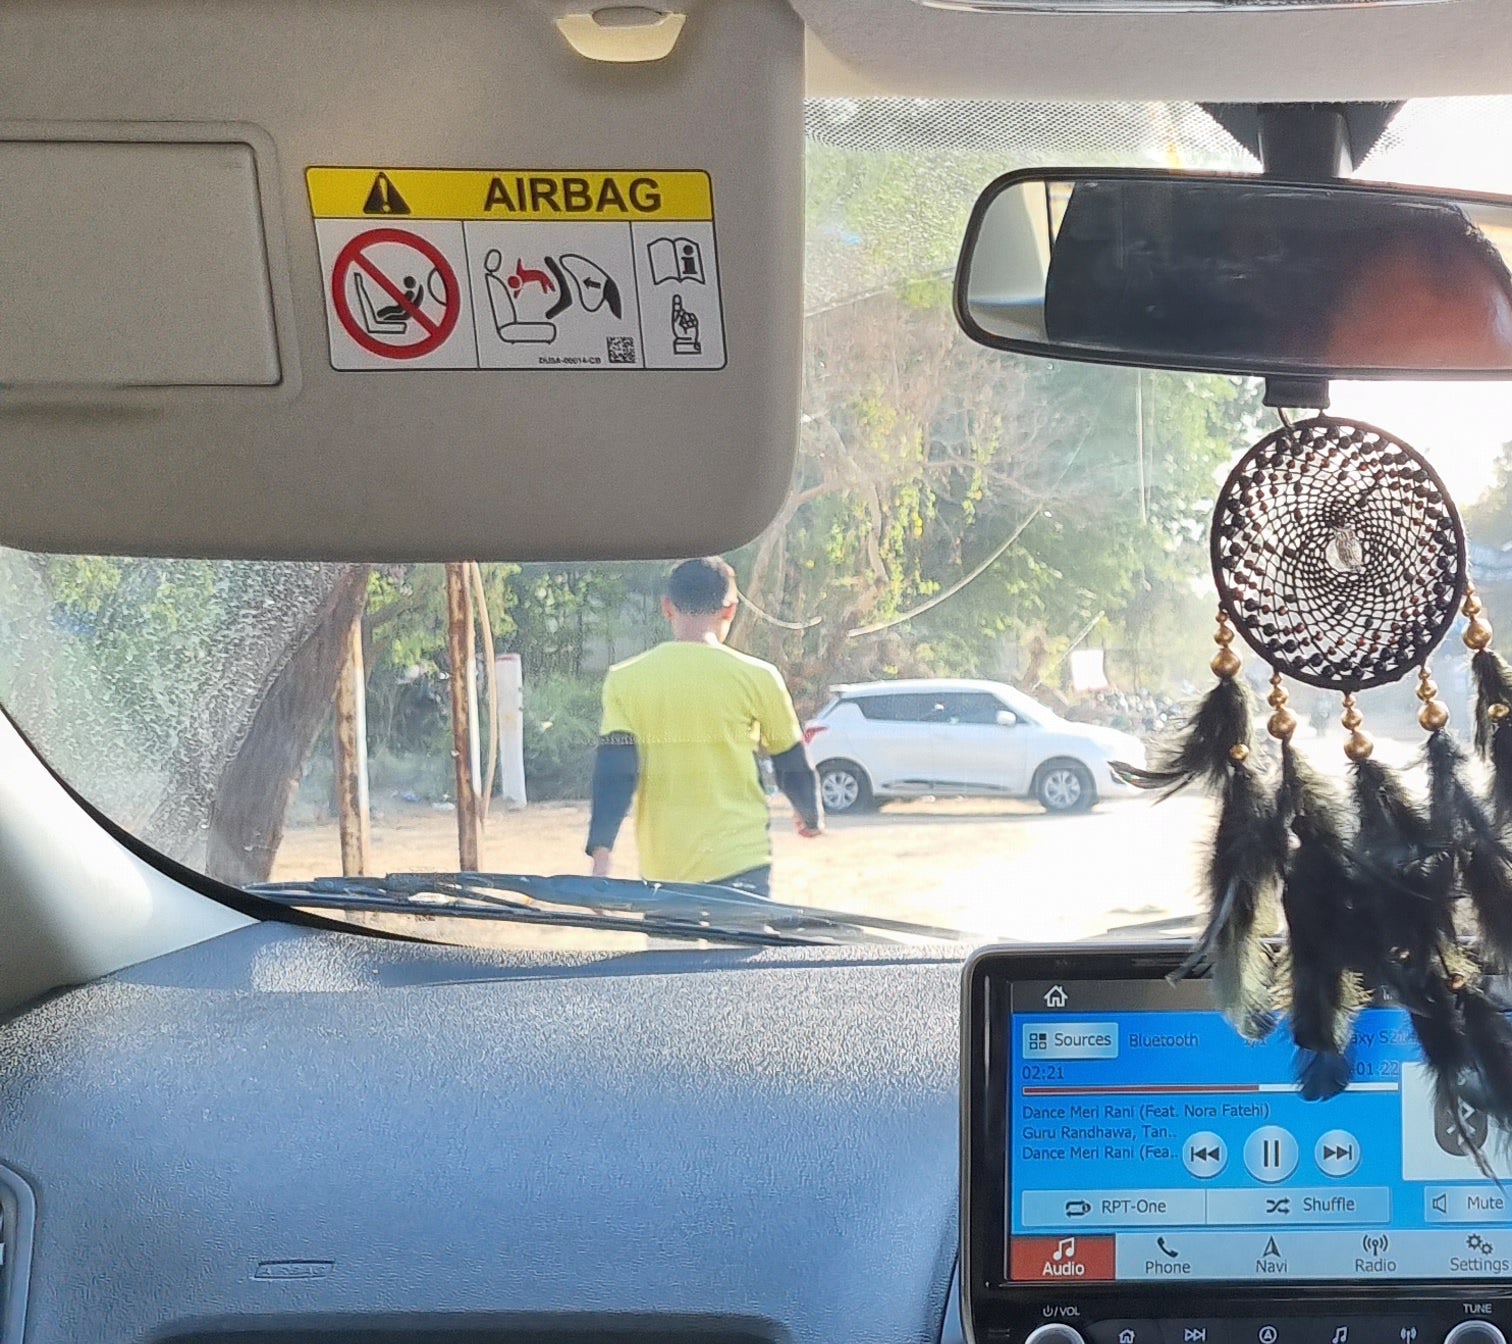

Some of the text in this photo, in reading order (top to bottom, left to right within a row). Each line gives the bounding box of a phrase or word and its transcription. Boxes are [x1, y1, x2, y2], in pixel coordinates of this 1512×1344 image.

[484, 177, 662, 213] AIRBAG
[1054, 1032, 1112, 1047] Sources
[1128, 1033, 1200, 1048] Bluetooth
[1021, 1065, 1065, 1080] 02:21
[1022, 1103, 1270, 1121] Dance Meri Rani (Feat. Nora Fatehi)
[1022, 1127, 1057, 1140] Guru
[1061, 1126, 1137, 1141] Randhawa,
[1022, 1147, 1065, 1160] Dance
[1070, 1146, 1099, 1159] Meri
[1104, 1146, 1134, 1159] Rani
[1101, 1199, 1167, 1214] RPT-One
[1302, 1196, 1356, 1212] Shuffle
[1467, 1195, 1504, 1210] Mute
[1042, 1260, 1085, 1276] Audio
[1145, 1260, 1191, 1274] Phone
[1256, 1259, 1288, 1273] Navi
[1355, 1258, 1397, 1272] Radio
[1449, 1256, 1510, 1274] Settings
[1462, 1303, 1493, 1313] TUNE
